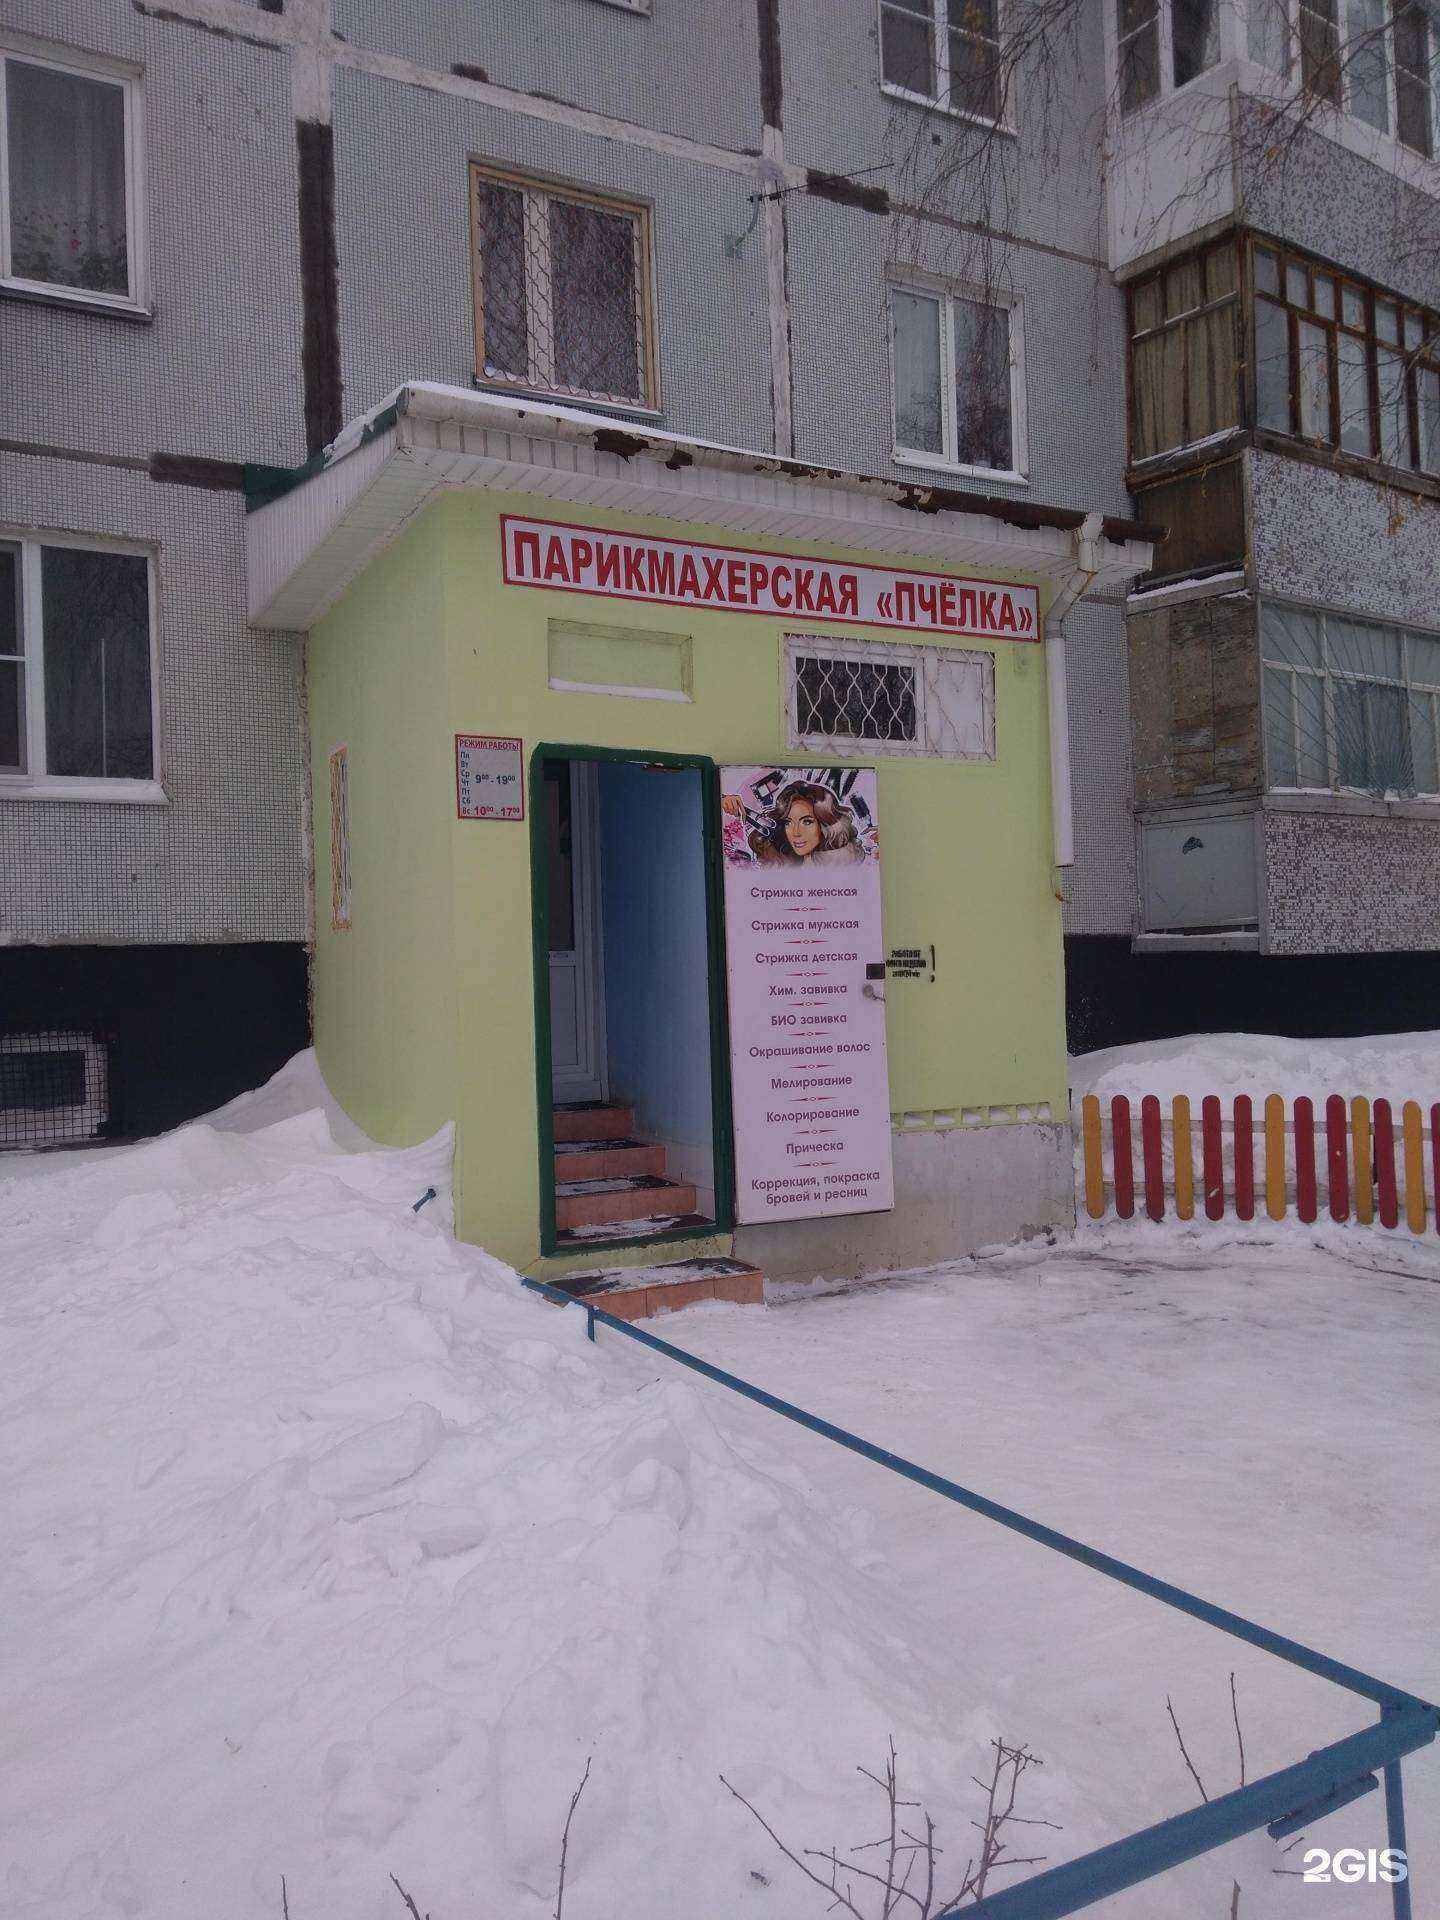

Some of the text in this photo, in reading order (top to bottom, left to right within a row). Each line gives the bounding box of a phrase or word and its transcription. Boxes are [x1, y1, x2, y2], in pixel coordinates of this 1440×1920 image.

[514, 530, 1032, 632] ПАРИКМАХЕРСКАЯ «ПЧЁЛКА»
[460, 740, 520, 751] РЕЖИМ РАБОТЫ
[750, 887, 857, 900] Стрижка женская
[751, 919, 859, 932] Стрижка мужская
[755, 952, 858, 965] Стрижка детская
[769, 985, 848, 996] Хим. завивка
[771, 1014, 848, 1026] БИО завивка
[750, 1042, 870, 1059] Окрашивание волос
[771, 1076, 852, 1090] Мелирование
[766, 1108, 860, 1124] Колорирование
[786, 1142, 844, 1156] Прическа
[752, 1171, 880, 1192] Коррекция, покраска
[766, 1188, 868, 1206] бровей и ресниц
